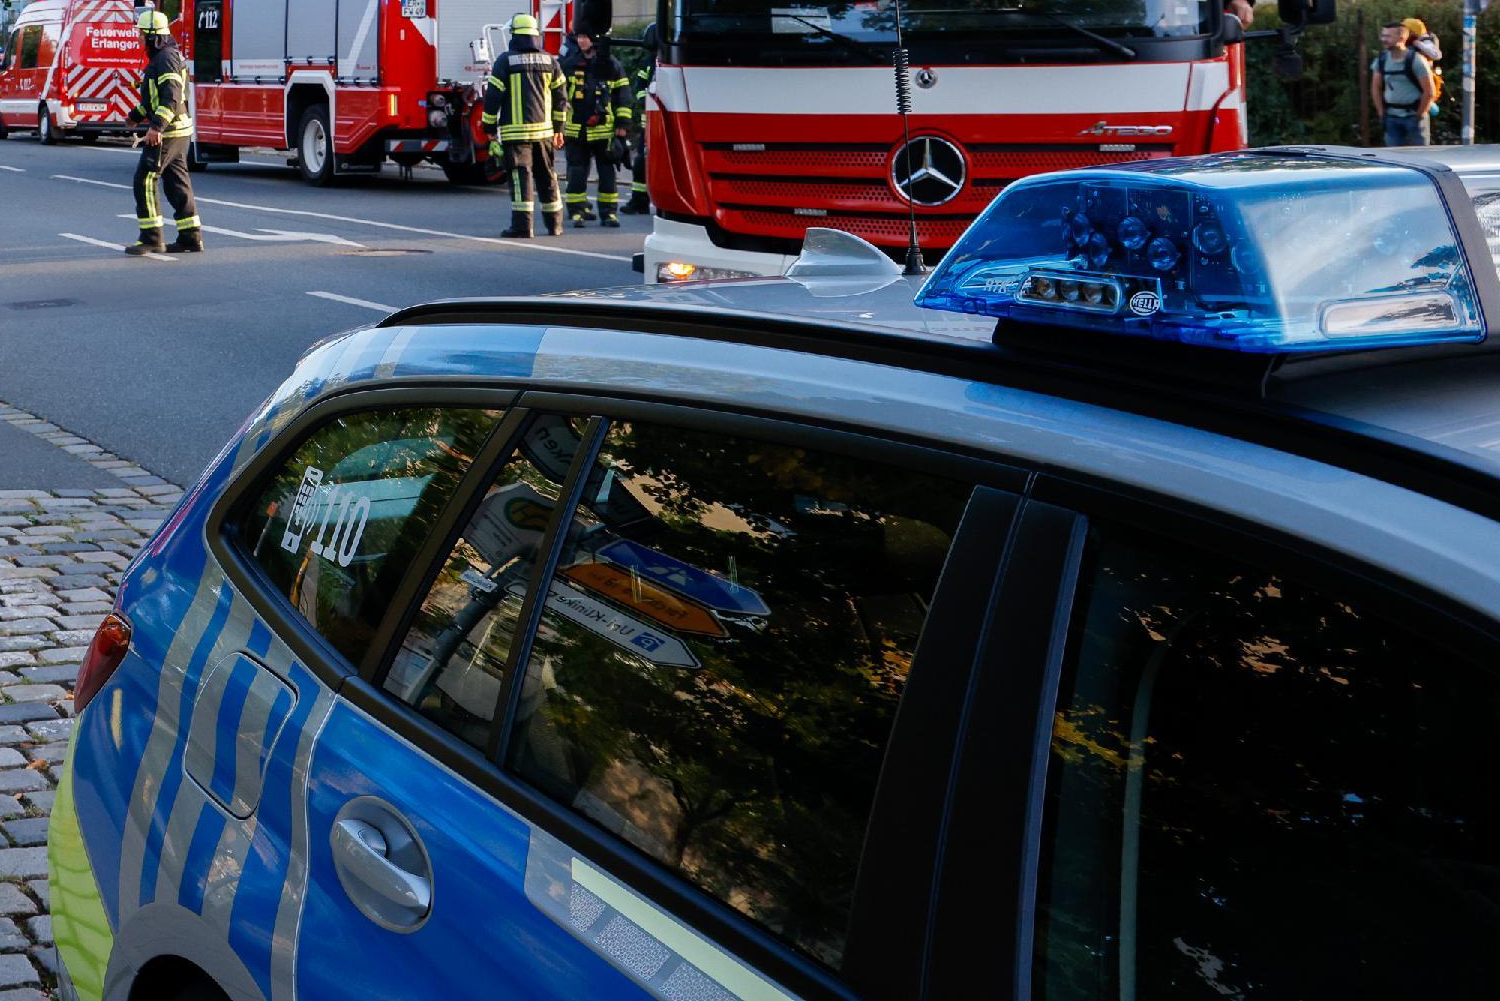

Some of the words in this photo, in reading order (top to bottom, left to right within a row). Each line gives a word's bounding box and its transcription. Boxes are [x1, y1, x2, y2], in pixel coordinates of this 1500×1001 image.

[204, 11, 218, 29] 112
[85, 26, 141, 38] Feuerweh
[91, 37, 140, 51] Erlangen
[1131, 297, 1161, 311] HELLA
[310, 484, 371, 567] 110
